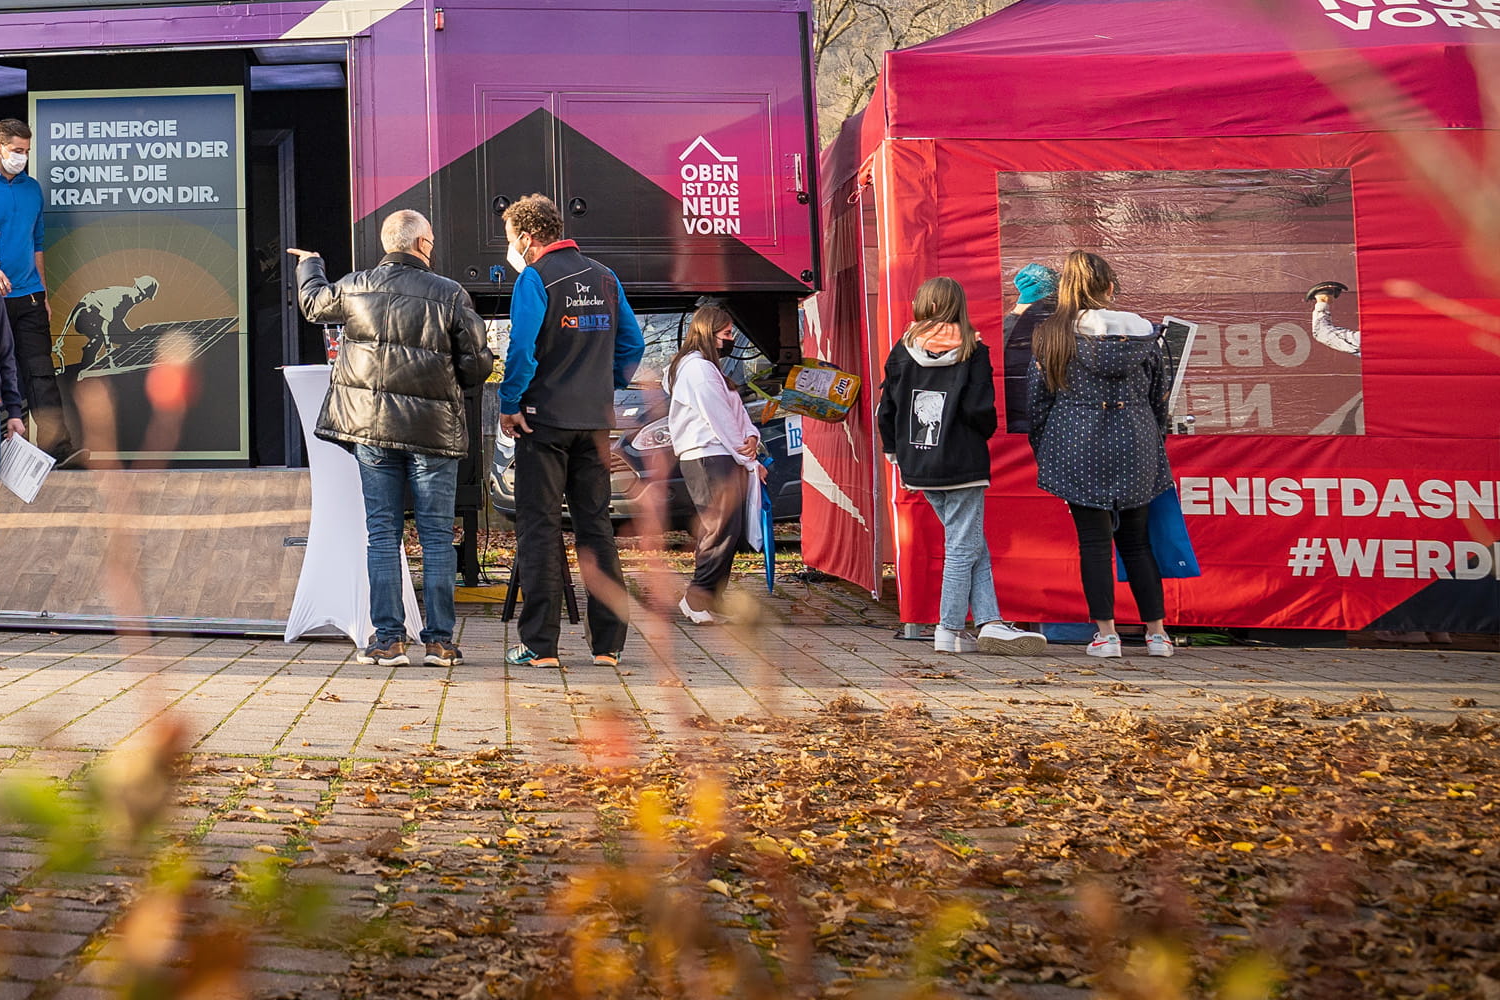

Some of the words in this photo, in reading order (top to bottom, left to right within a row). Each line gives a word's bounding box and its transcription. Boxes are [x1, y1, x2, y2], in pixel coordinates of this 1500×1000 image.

[51, 123, 84, 139] DIE
[88, 120, 178, 139] ENERGIE
[51, 143, 132, 161] KOMMT
[135, 142, 182, 159] VON
[186, 141, 229, 158] DER
[50, 165, 129, 183] SONNE.
[133, 164, 167, 182] DIE
[681, 164, 739, 182] OBEN
[51, 188, 123, 205] KRAFT
[127, 186, 174, 204] VON
[178, 186, 220, 203] DIR.
[682, 182, 704, 196] IST
[707, 182, 739, 196] DAS
[683, 197, 740, 216] NEUE
[683, 217, 741, 235] VORN
[574, 282, 591, 294] Der
[836, 378, 847, 395] dm
